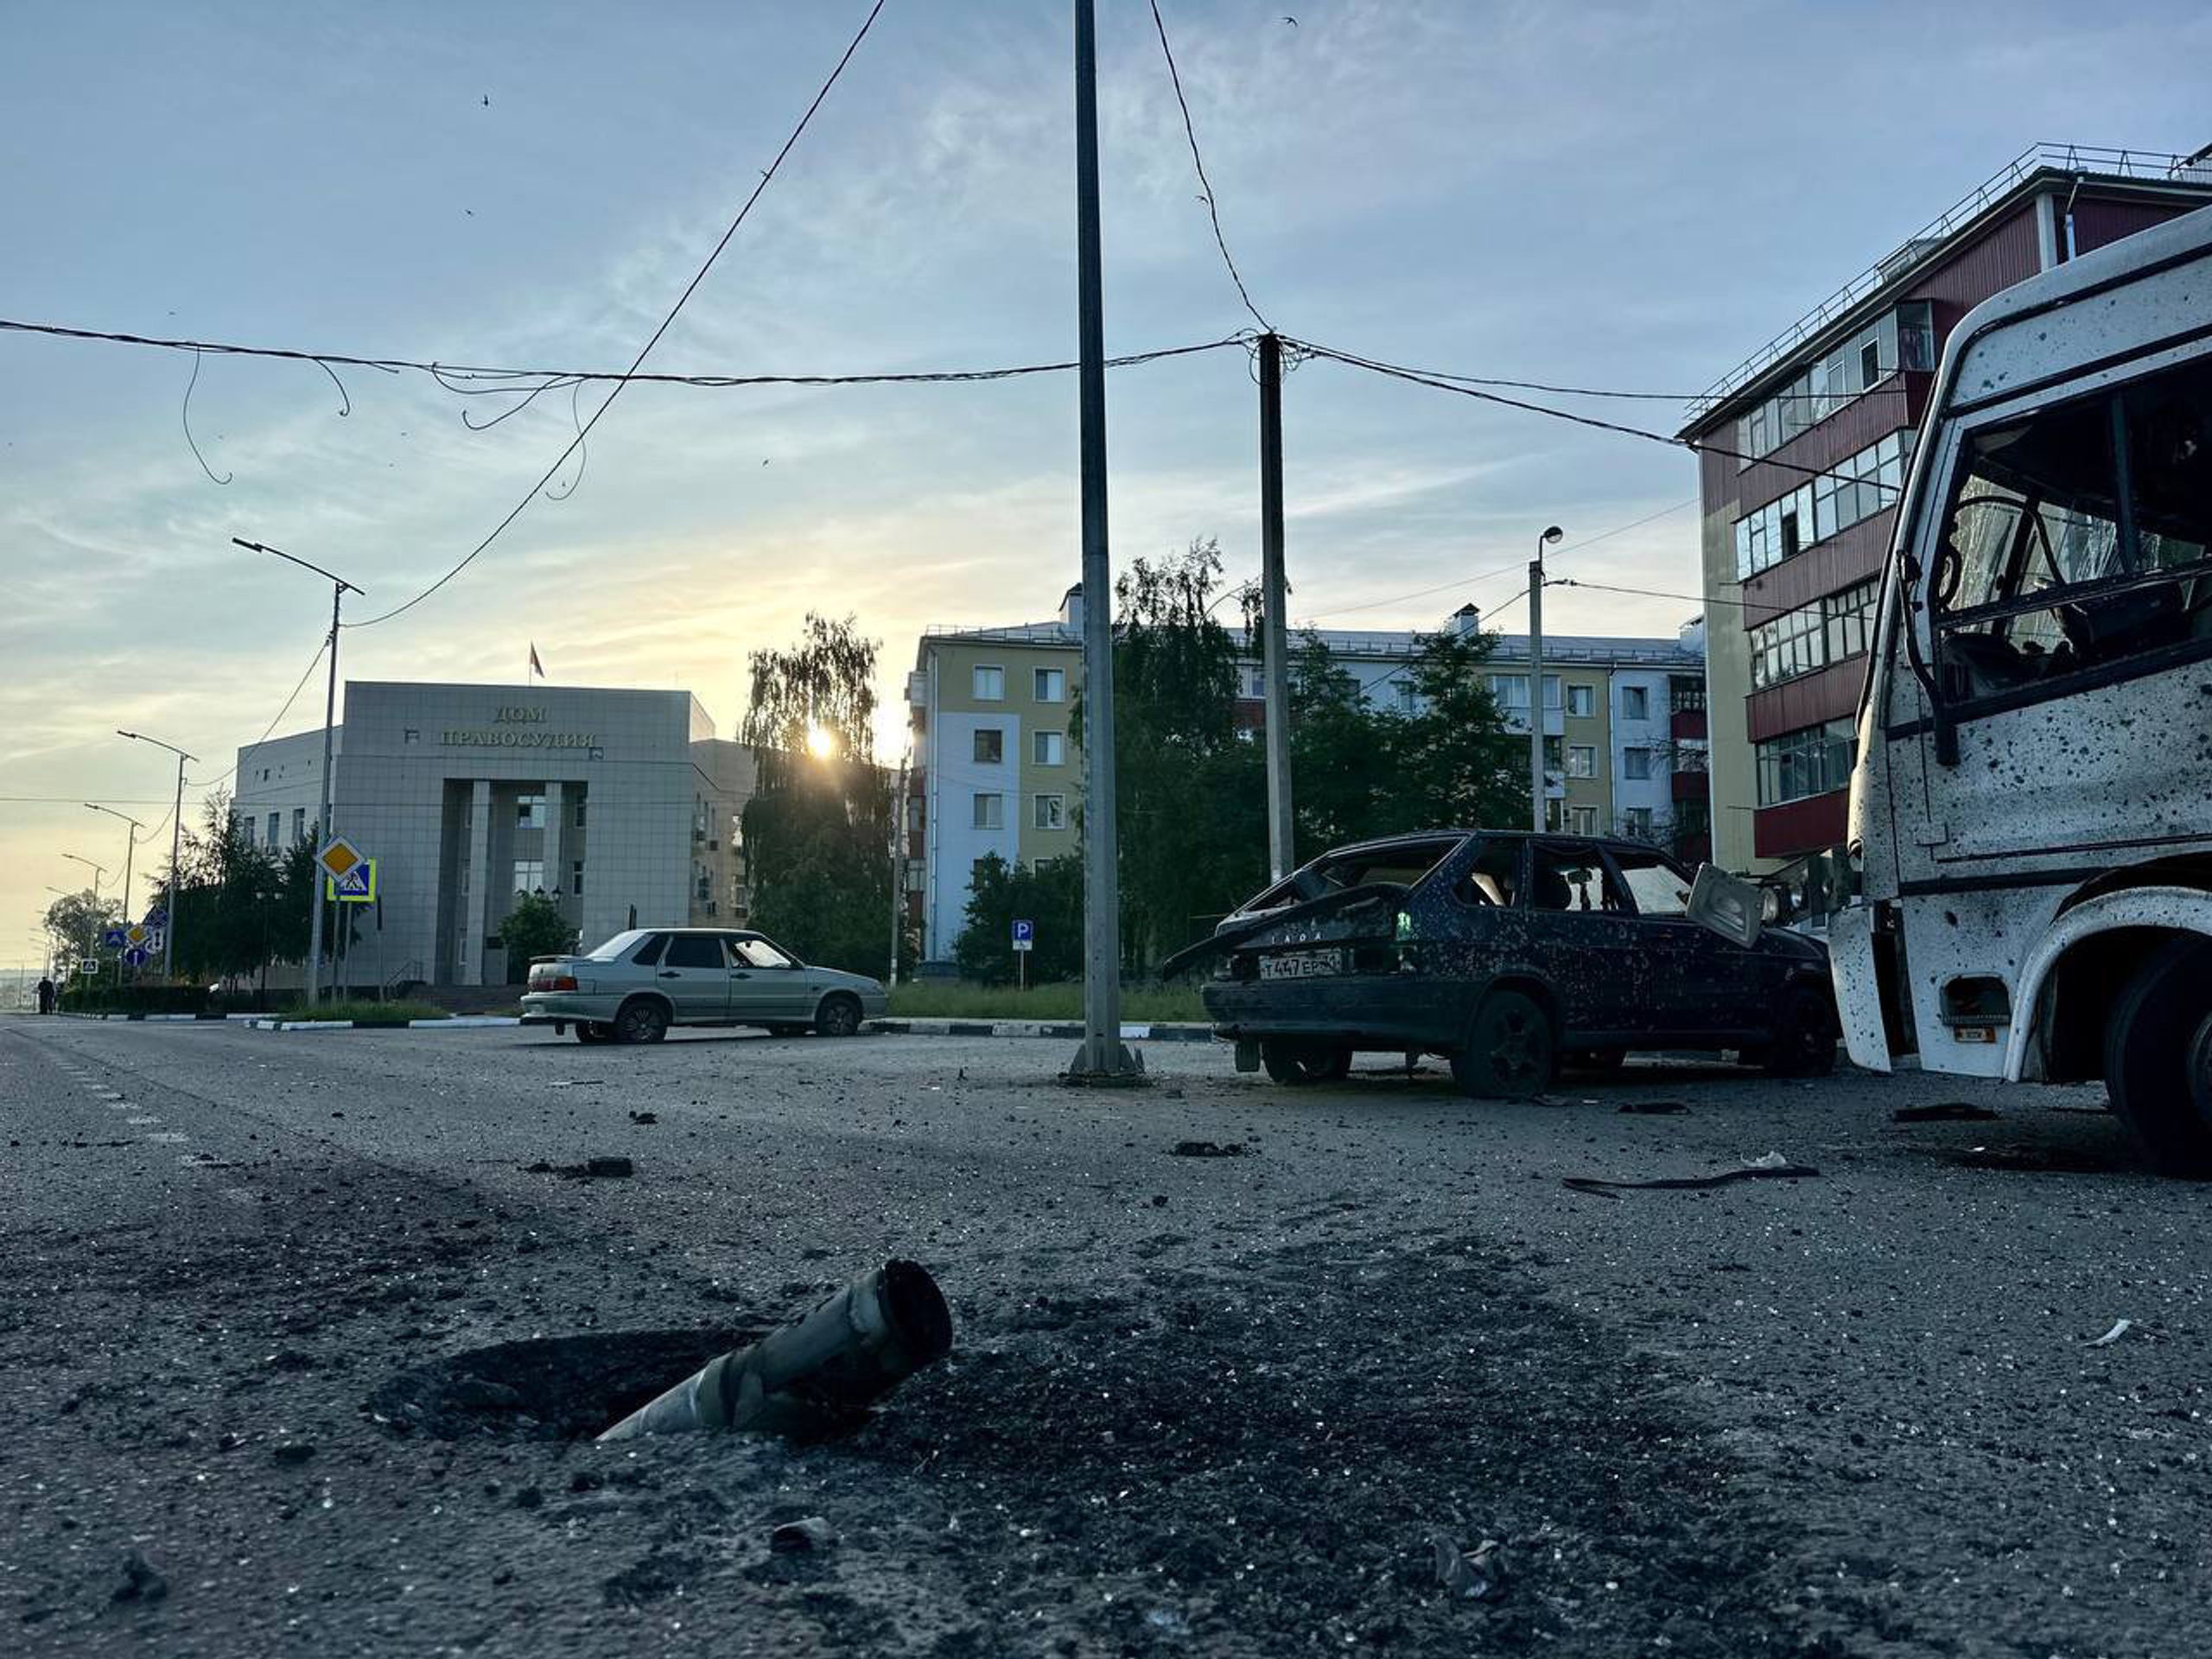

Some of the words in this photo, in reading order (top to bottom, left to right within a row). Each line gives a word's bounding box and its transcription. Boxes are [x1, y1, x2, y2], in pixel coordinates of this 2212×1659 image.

[494, 705, 547, 724] ДОМ
[441, 730, 595, 748] ПРАВОСУДИЯ
[1017, 923, 1029, 938] P
[1271, 931, 1322, 944] LADA
